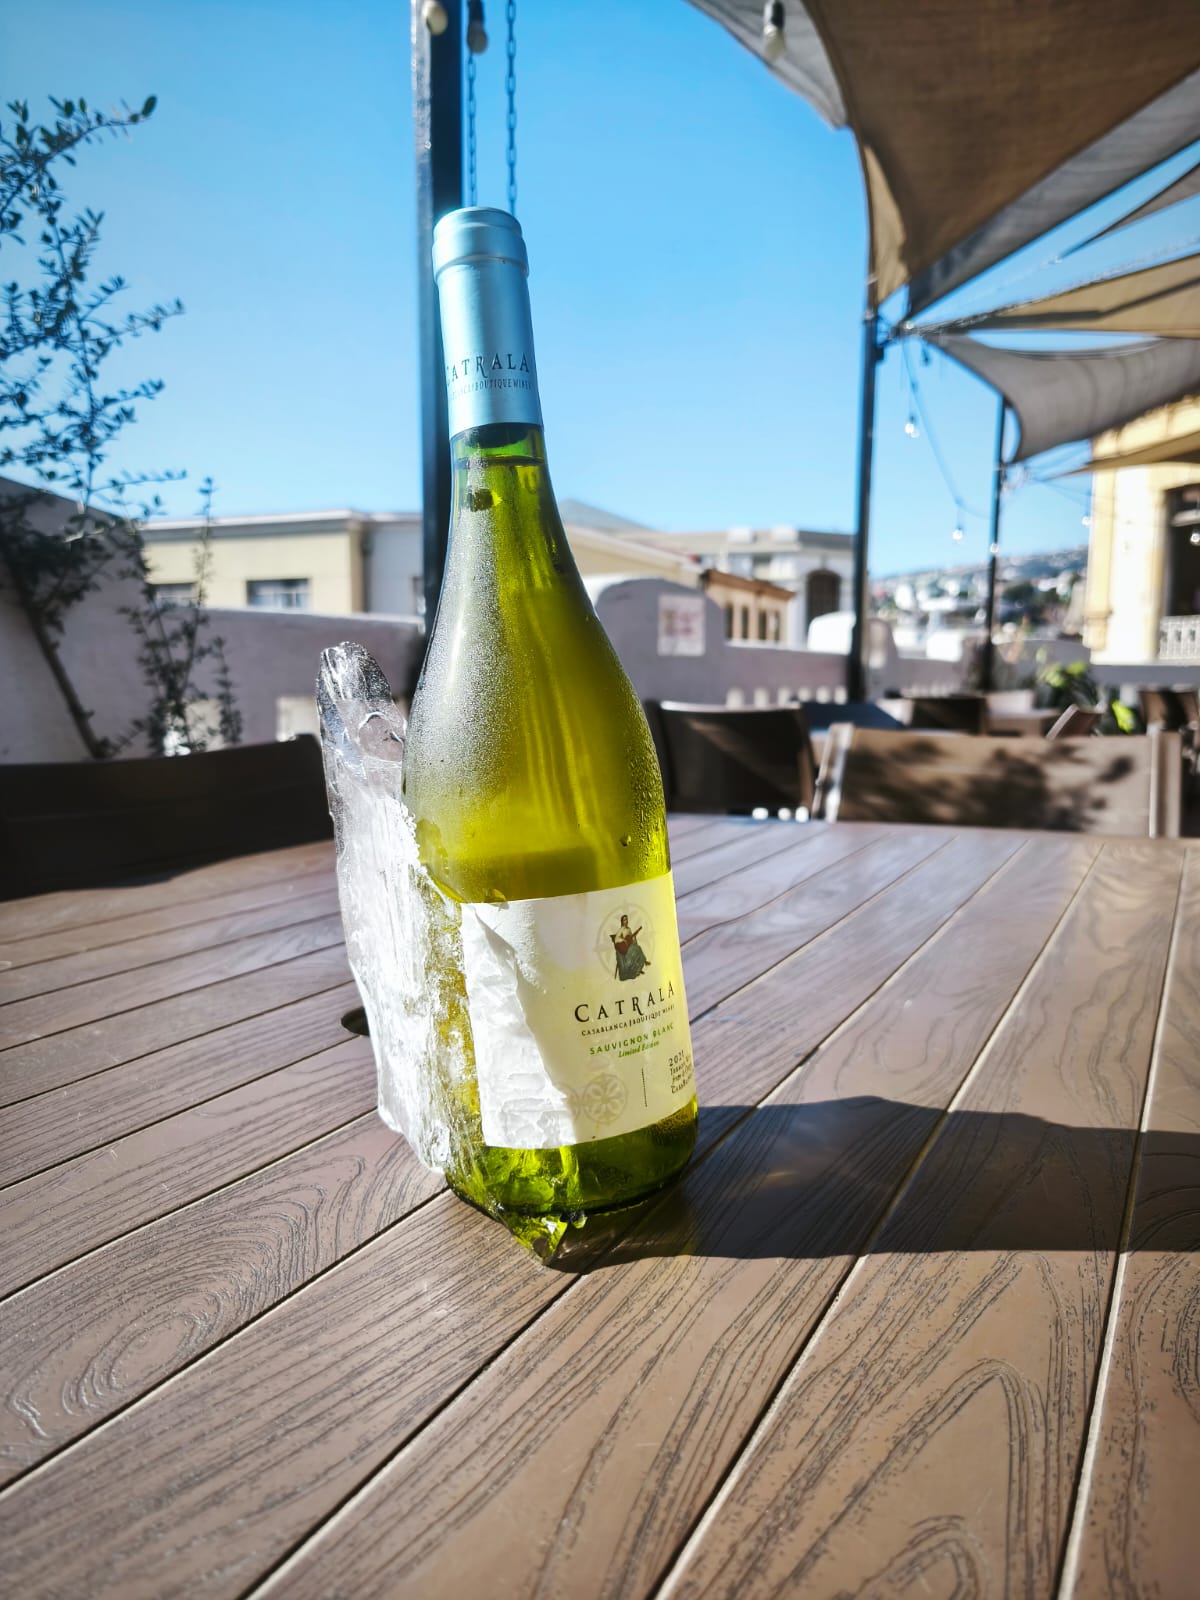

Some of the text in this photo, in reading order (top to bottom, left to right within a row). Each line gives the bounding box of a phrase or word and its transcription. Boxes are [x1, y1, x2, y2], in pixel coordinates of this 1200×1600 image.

[574, 980, 675, 1022] CATRALA
[581, 1022, 627, 1037] CASABLANCA
[589, 1033, 649, 1056] SAUVIGNON
